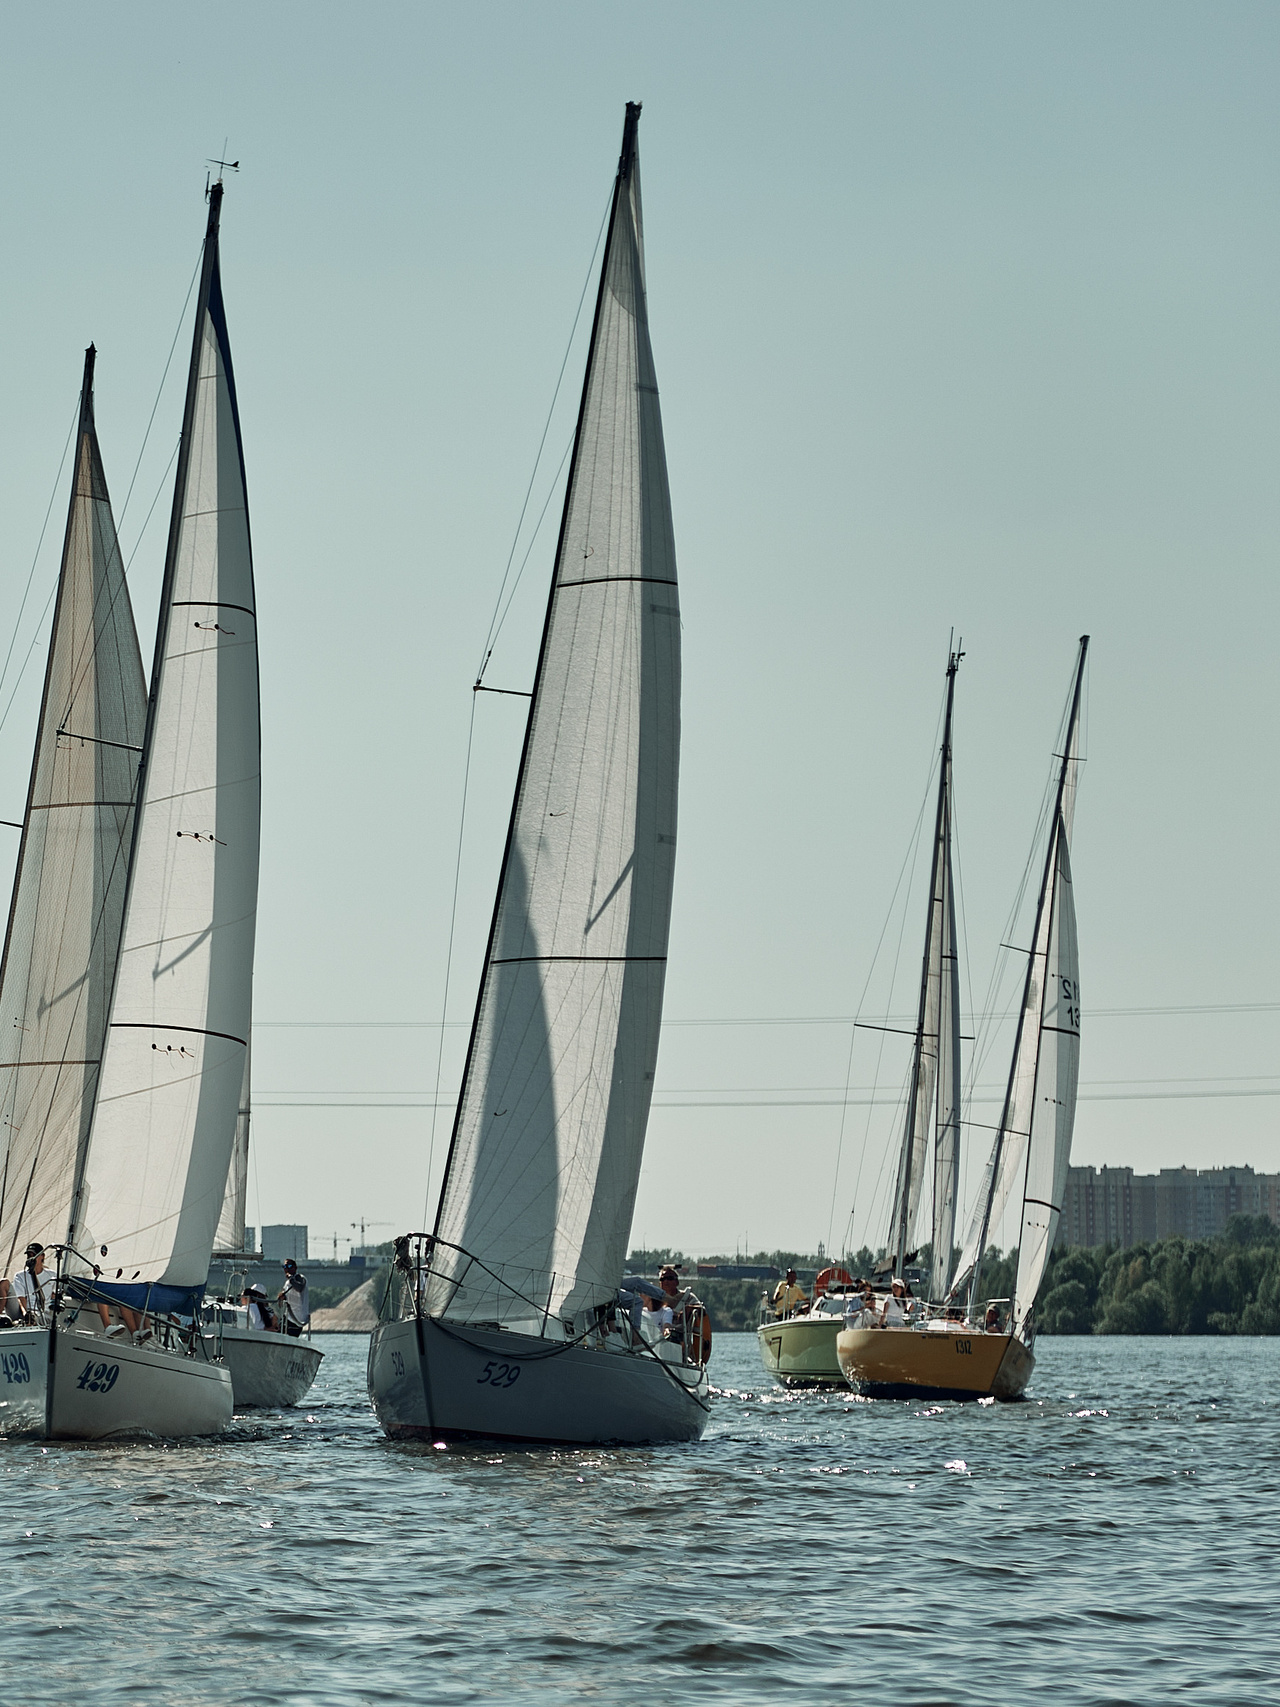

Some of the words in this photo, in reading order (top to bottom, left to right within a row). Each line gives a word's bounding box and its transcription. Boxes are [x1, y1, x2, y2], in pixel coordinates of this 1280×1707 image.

[956, 1340, 973, 1355] 1312
[1, 1352, 30, 1383] 429
[76, 1360, 120, 1393] 429
[477, 1361, 521, 1388] 529
